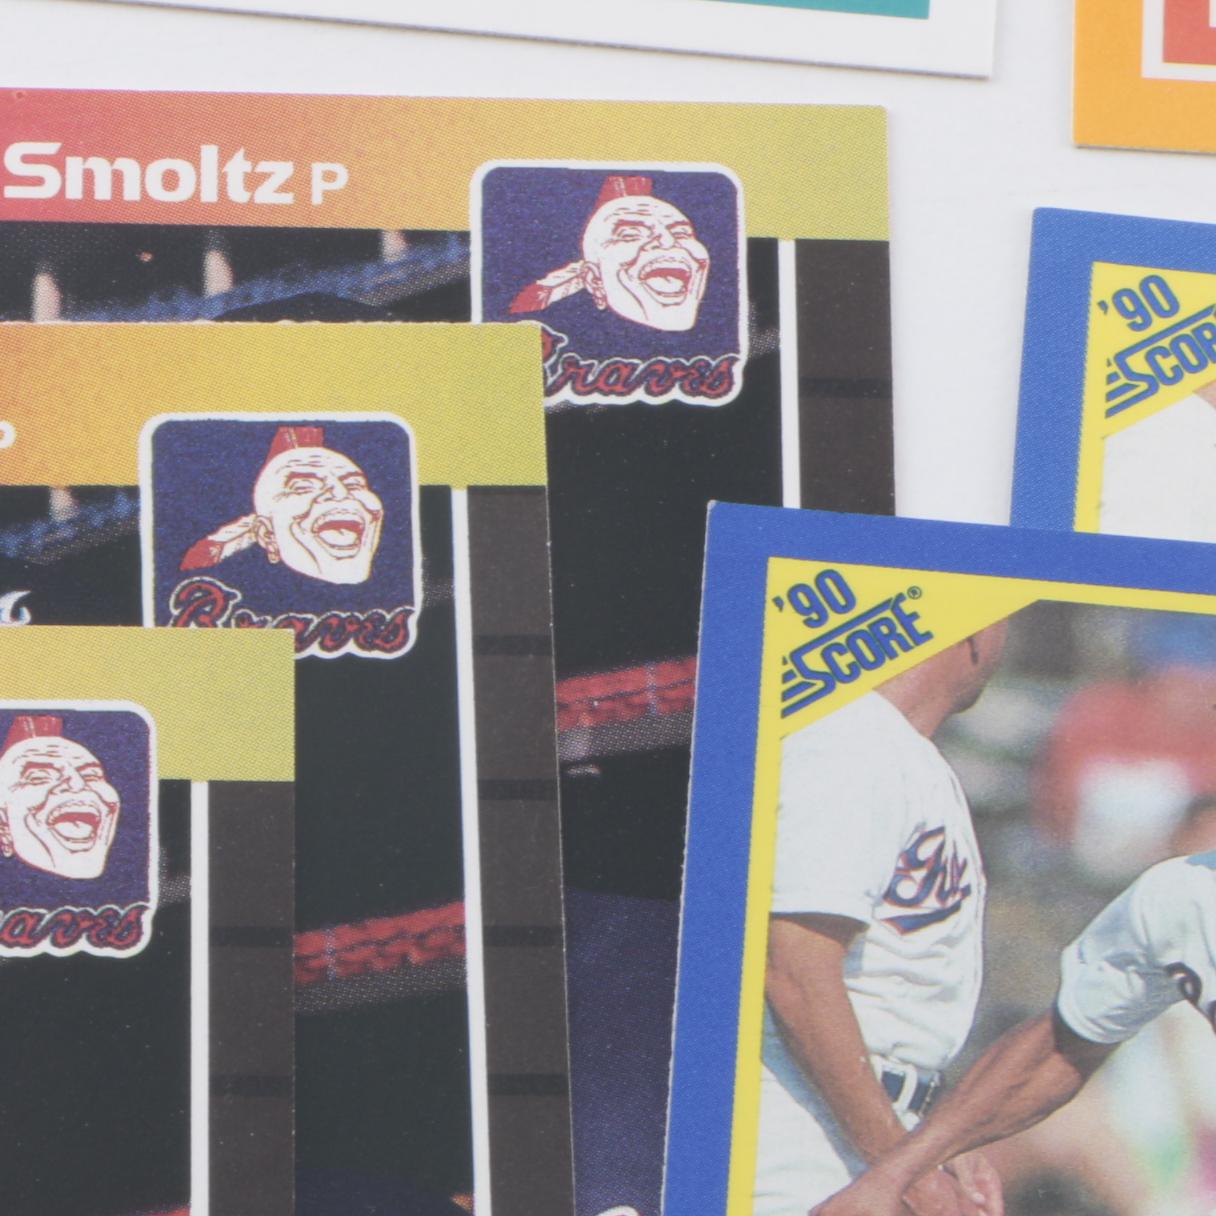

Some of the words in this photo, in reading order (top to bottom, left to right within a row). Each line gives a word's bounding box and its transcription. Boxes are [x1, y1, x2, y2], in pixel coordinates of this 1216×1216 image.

[3, 141, 295, 205] Smoltz
[310, 162, 349, 205] P
[1097, 274, 1181, 332] '90
[544, 325, 741, 400] raves
[771, 568, 857, 629] '90
